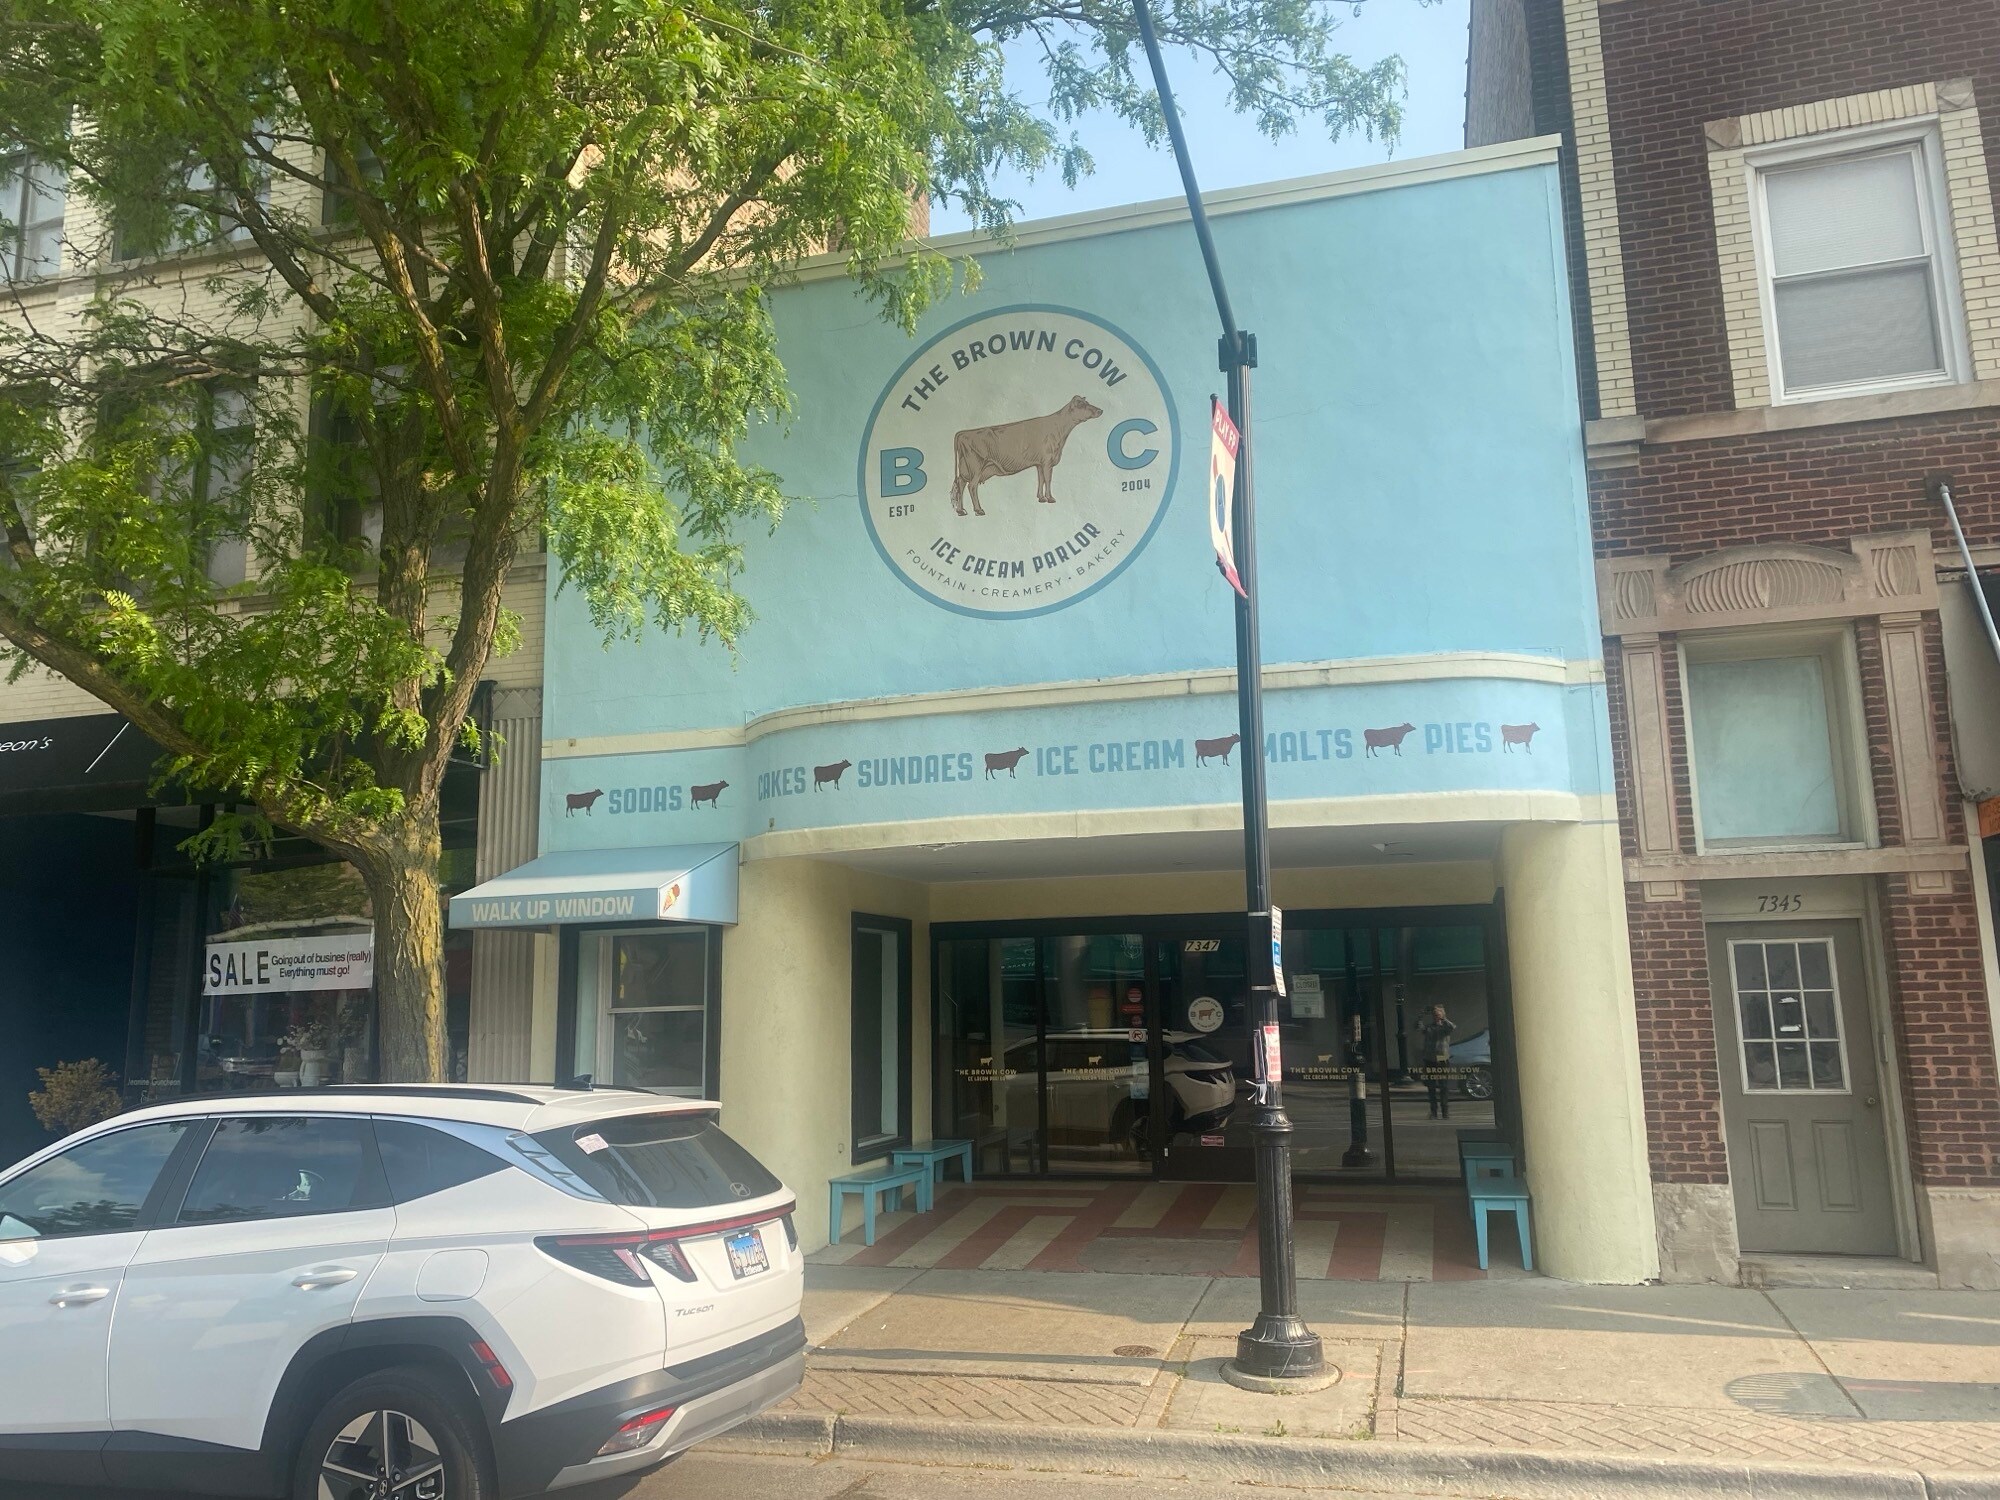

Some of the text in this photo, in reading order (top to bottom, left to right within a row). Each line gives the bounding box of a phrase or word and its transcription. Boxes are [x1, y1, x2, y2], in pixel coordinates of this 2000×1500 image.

[901, 330, 1128, 413] THE BROWN COW
[1106, 418, 1160, 470] C
[880, 446, 928, 498] B
[1121, 478, 1151, 492] 2004
[906, 529, 1126, 598] FOUNTAIN CREAMERY BAKERY
[930, 522, 1101, 579] ICE CREAM PARLOR
[0, 736, 53, 752] eon's
[608, 785, 683, 815] SODAS
[758, 766, 806, 801] CAKES
[857, 752, 973, 789] SUNDAES
[1036, 745, 1079, 776] ICE
[1088, 738, 1185, 774] CREAM
[1426, 721, 1492, 754] PIES
[472, 896, 635, 922] WALK UP WINDOW
[1758, 894, 1802, 912] 7345
[271, 950, 372, 967] Going out of busines (really)
[1186, 940, 1220, 951] 7347
[209, 950, 271, 988] SALE
[279, 965, 350, 979] Everything must go!
[675, 1304, 715, 1317] Tucson
